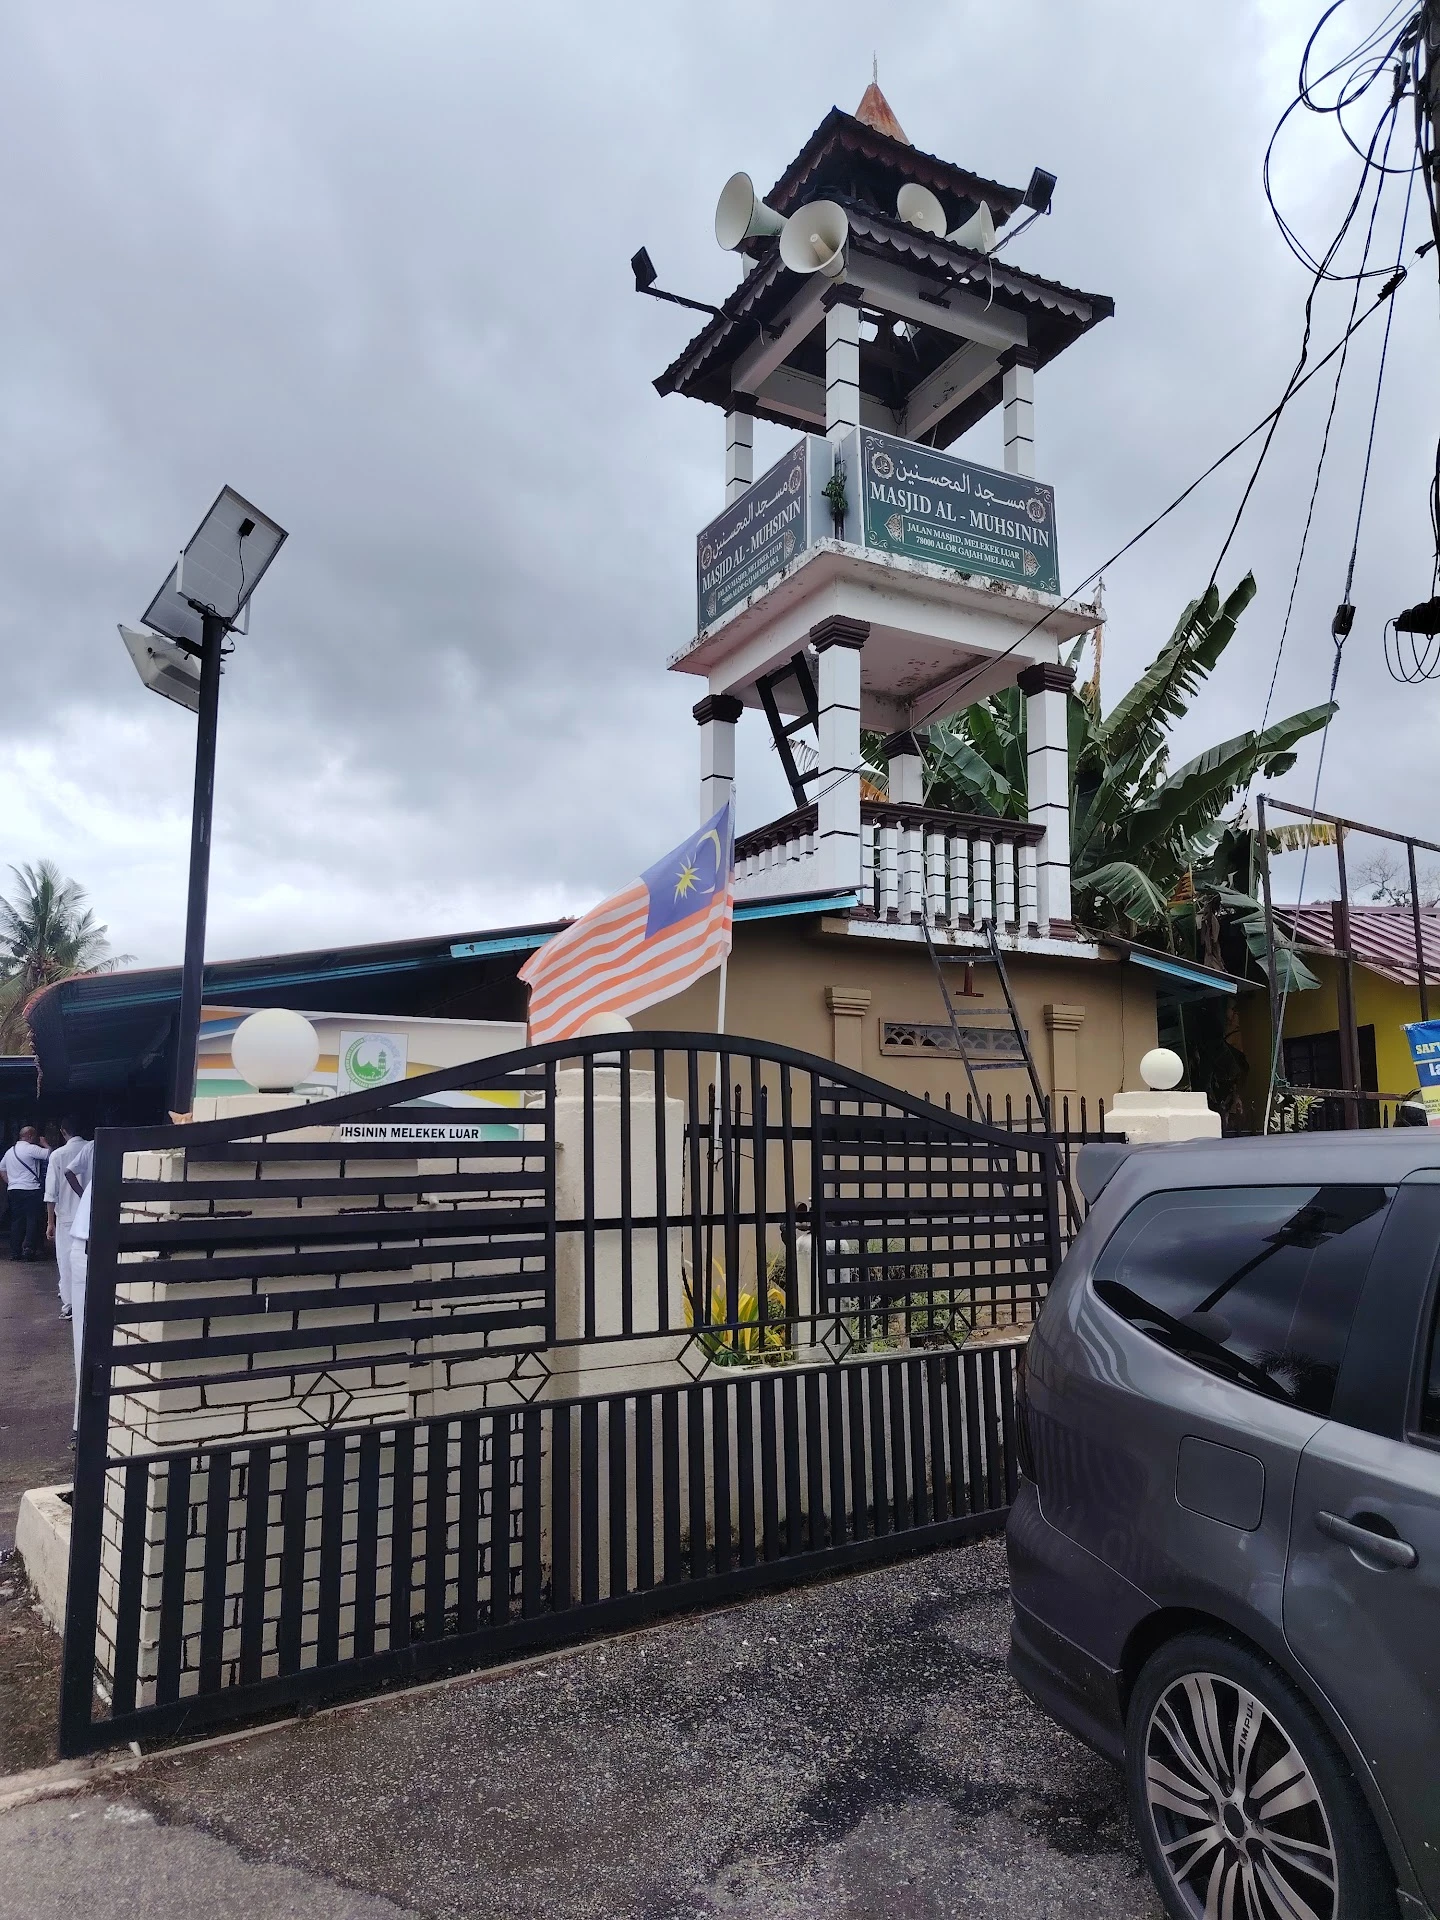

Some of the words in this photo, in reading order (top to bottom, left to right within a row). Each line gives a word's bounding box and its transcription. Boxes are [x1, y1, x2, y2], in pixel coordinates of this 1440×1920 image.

[870, 481, 932, 515] MASJID
[935, 500, 957, 522] AL
[969, 509, 1050, 548] MUHSININ
[974, 483, 1026, 511] مسجد
[702, 555, 733, 594] MASJID
[733, 545, 746, 569] AL
[750, 496, 802, 554] MUHSININ
[907, 522, 933, 537] JALAN
[933, 530, 963, 546] MASJID,
[963, 538, 1000, 556] MELEKEK
[1000, 548, 1020, 560] LUAR
[935, 542, 958, 554] ALOR
[958, 547, 984, 560] GAJAH
[984, 554, 1015, 569] MELAKA
[390, 1127, 446, 1139] MELEKEK
[449, 1128, 479, 1139] LUAR
[1239, 1701, 1254, 1745] IMPUL
